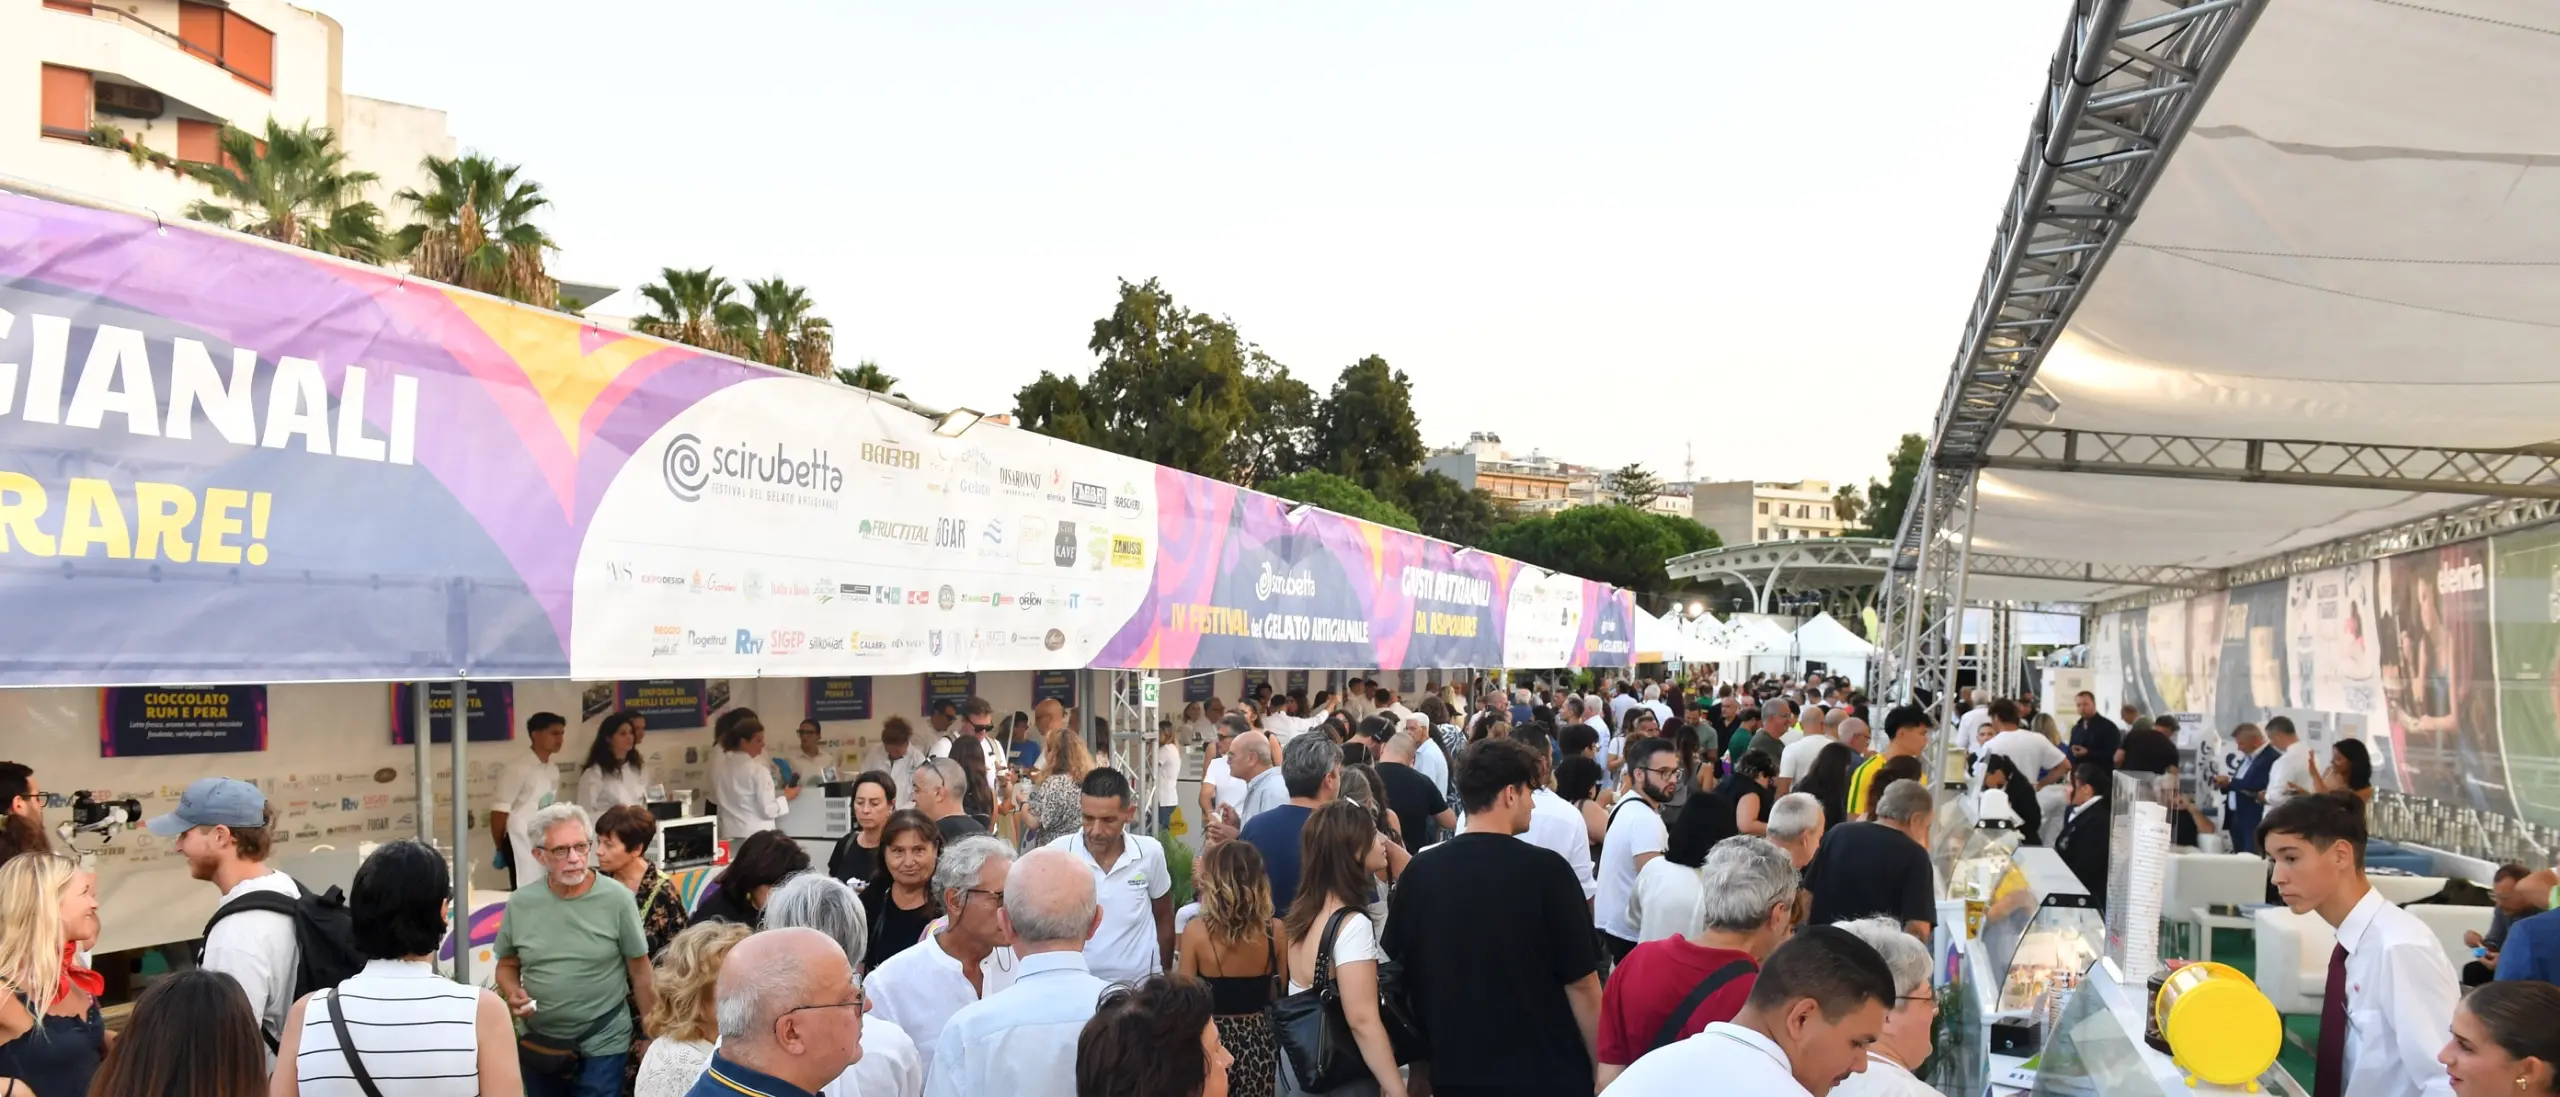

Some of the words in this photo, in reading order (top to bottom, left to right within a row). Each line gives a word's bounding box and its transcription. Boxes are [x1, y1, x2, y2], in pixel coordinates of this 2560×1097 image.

[0, 306, 420, 466] IANALI
[712, 441, 843, 493] scirubetta
[861, 442, 920, 470] BABBI
[712, 482, 745, 498] FESTIVAL
[749, 488, 762, 500] DEL
[766, 490, 794, 504] GELATO
[0, 471, 272, 566] RARE!
[1113, 539, 1142, 556] ZANUSSI
[2437, 557, 2484, 595] elenka
[1018, 594, 1043, 607] ORION
[1190, 604, 1250, 637] FESTIVAL
[1264, 612, 1310, 641] GELATO
[770, 629, 806, 649] SIGEP
[144, 692, 229, 705] CIOCCOLATO
[146, 706, 179, 718] RUM
[182, 706, 190, 718] E
[193, 706, 228, 718] PERA
[367, 817, 389, 830] FUGAR
